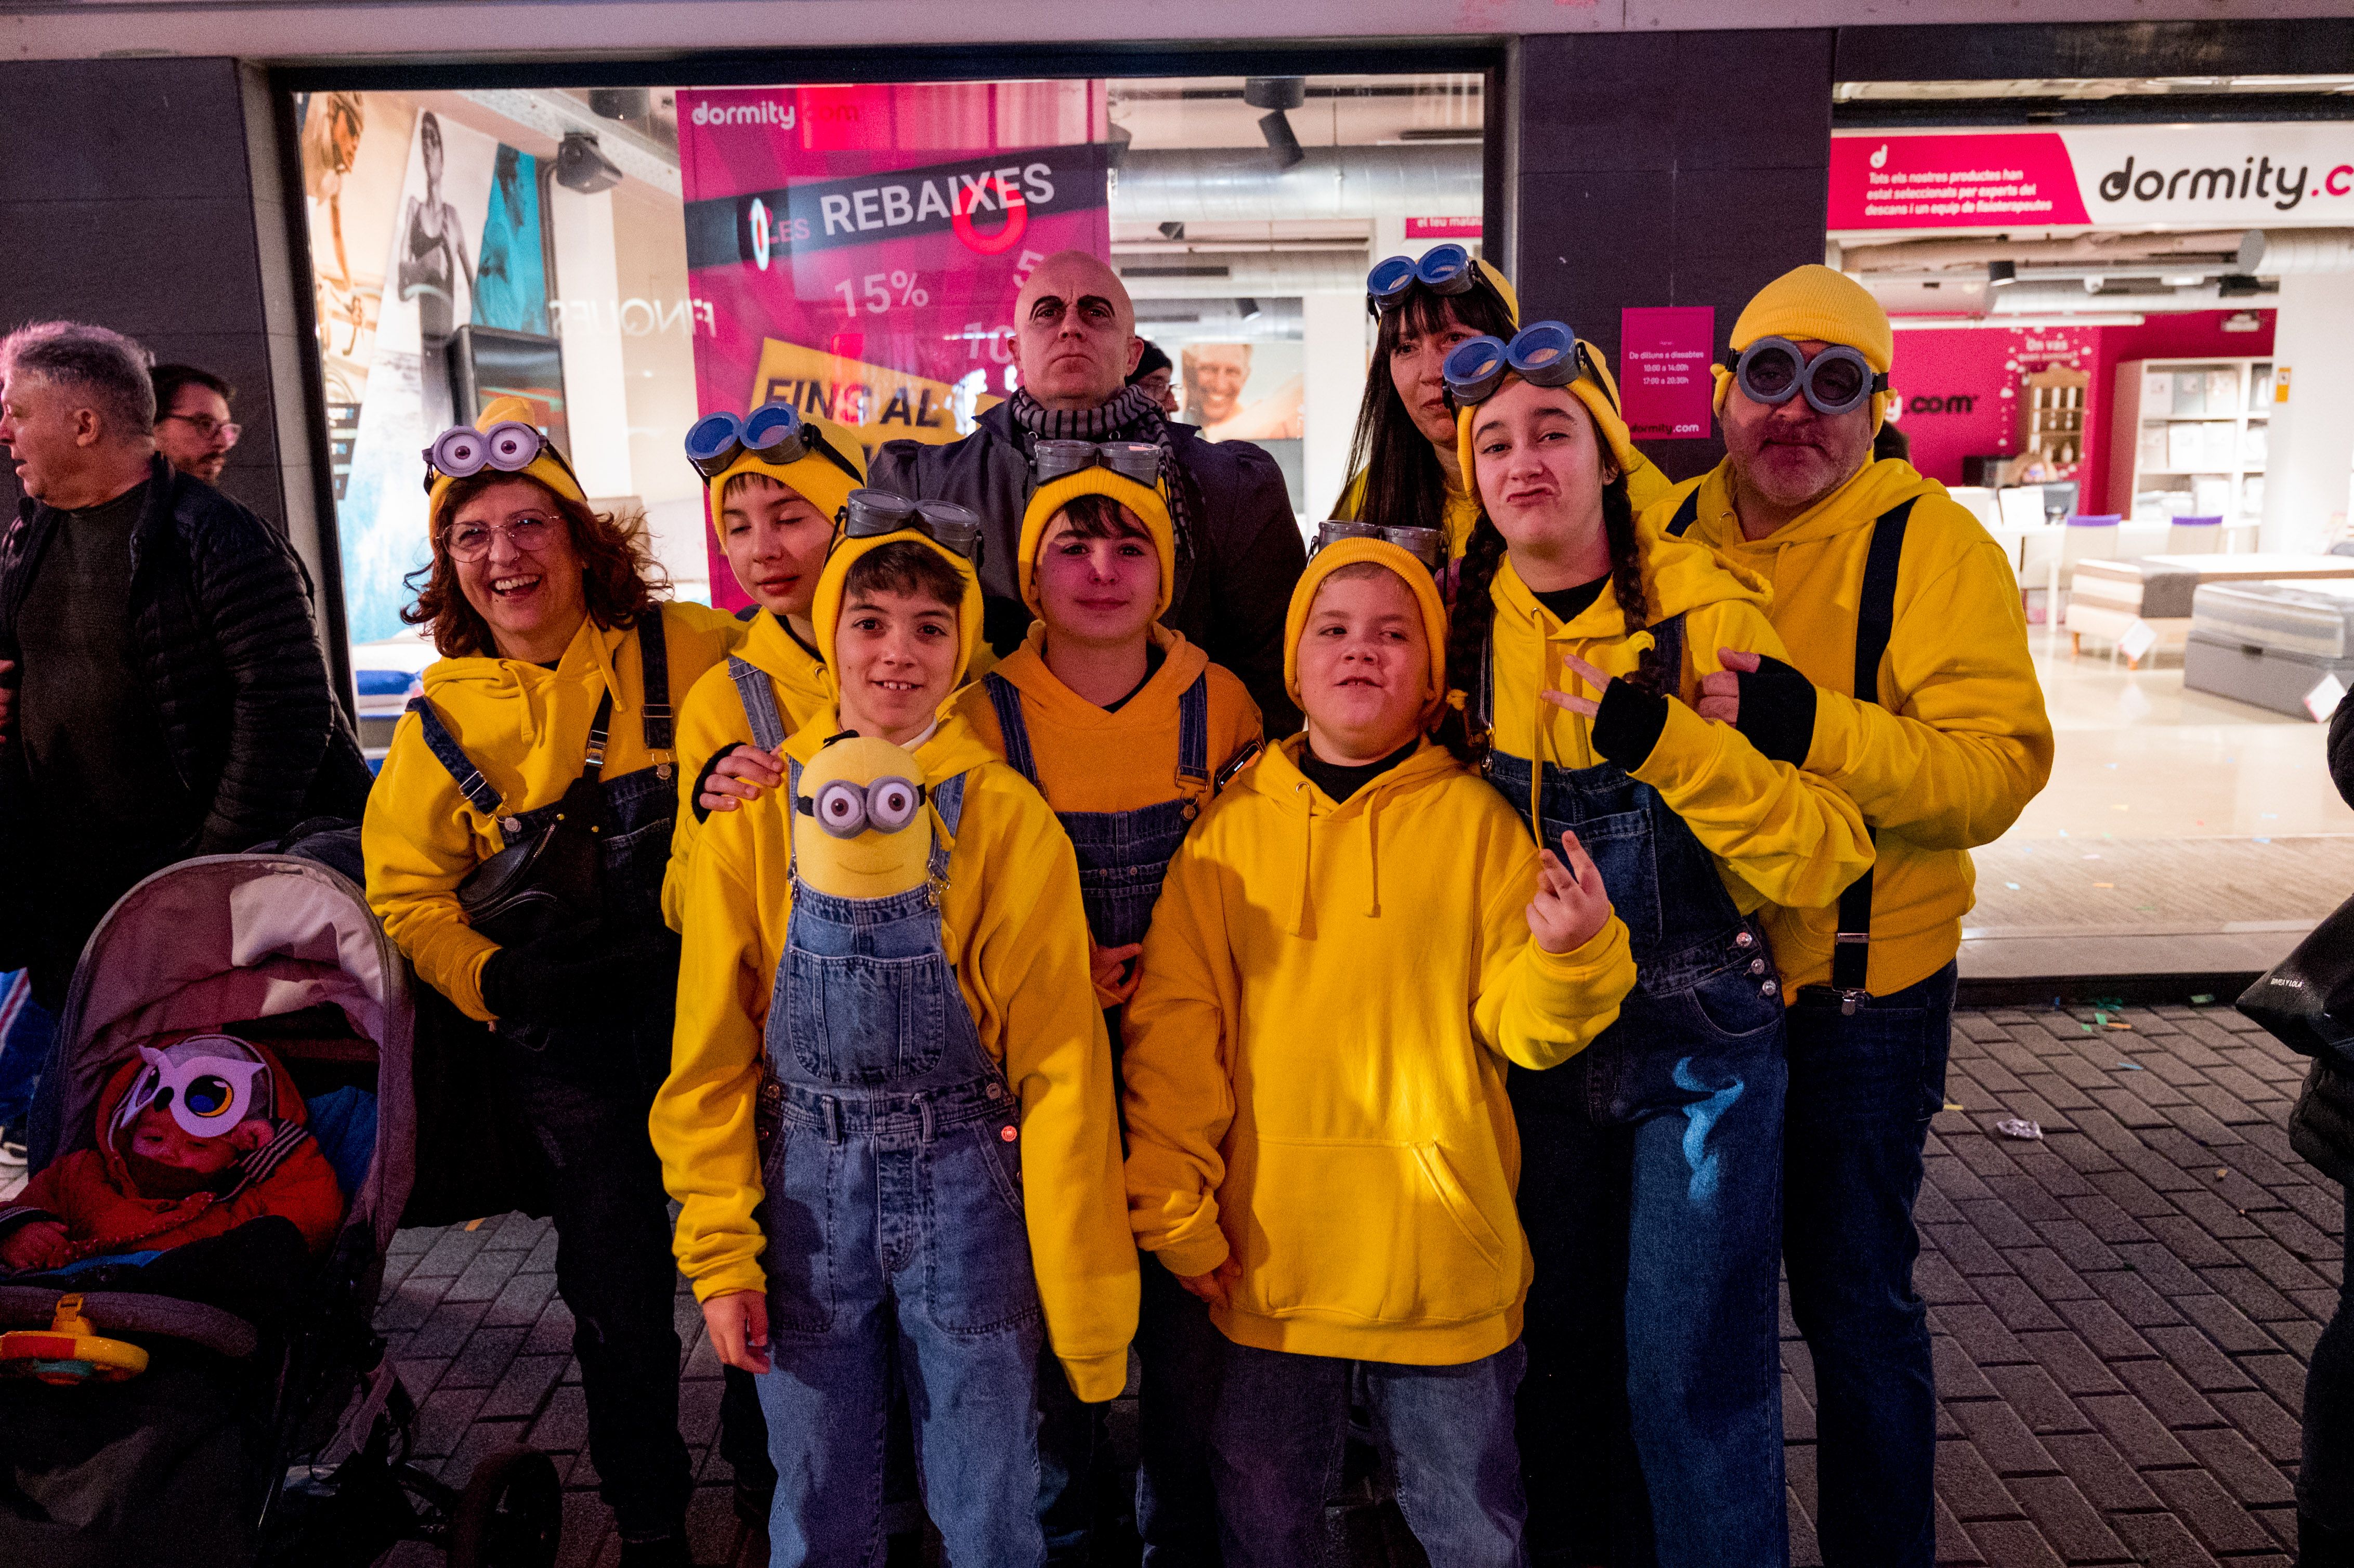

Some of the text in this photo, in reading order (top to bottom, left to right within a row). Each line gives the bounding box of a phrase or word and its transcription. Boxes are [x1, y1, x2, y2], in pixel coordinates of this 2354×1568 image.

[1869, 168, 2023, 185] Tots els nostres productes han
[820, 164, 1055, 235] REBAIXES
[1866, 182, 2037, 200] estat seleccionats per experts del
[1865, 203, 1908, 216] descans
[1915, 204, 1930, 215] un
[1930, 201, 1960, 216] equip
[1961, 200, 1976, 213] de
[1976, 199, 2054, 214] fisioterapeutes
[835, 269, 929, 318] 15%
[1629, 351, 1639, 360] De
[1670, 350, 1704, 359] dissabtes
[880, 385, 943, 428] AL
[1630, 423, 1699, 435] dormity.com
